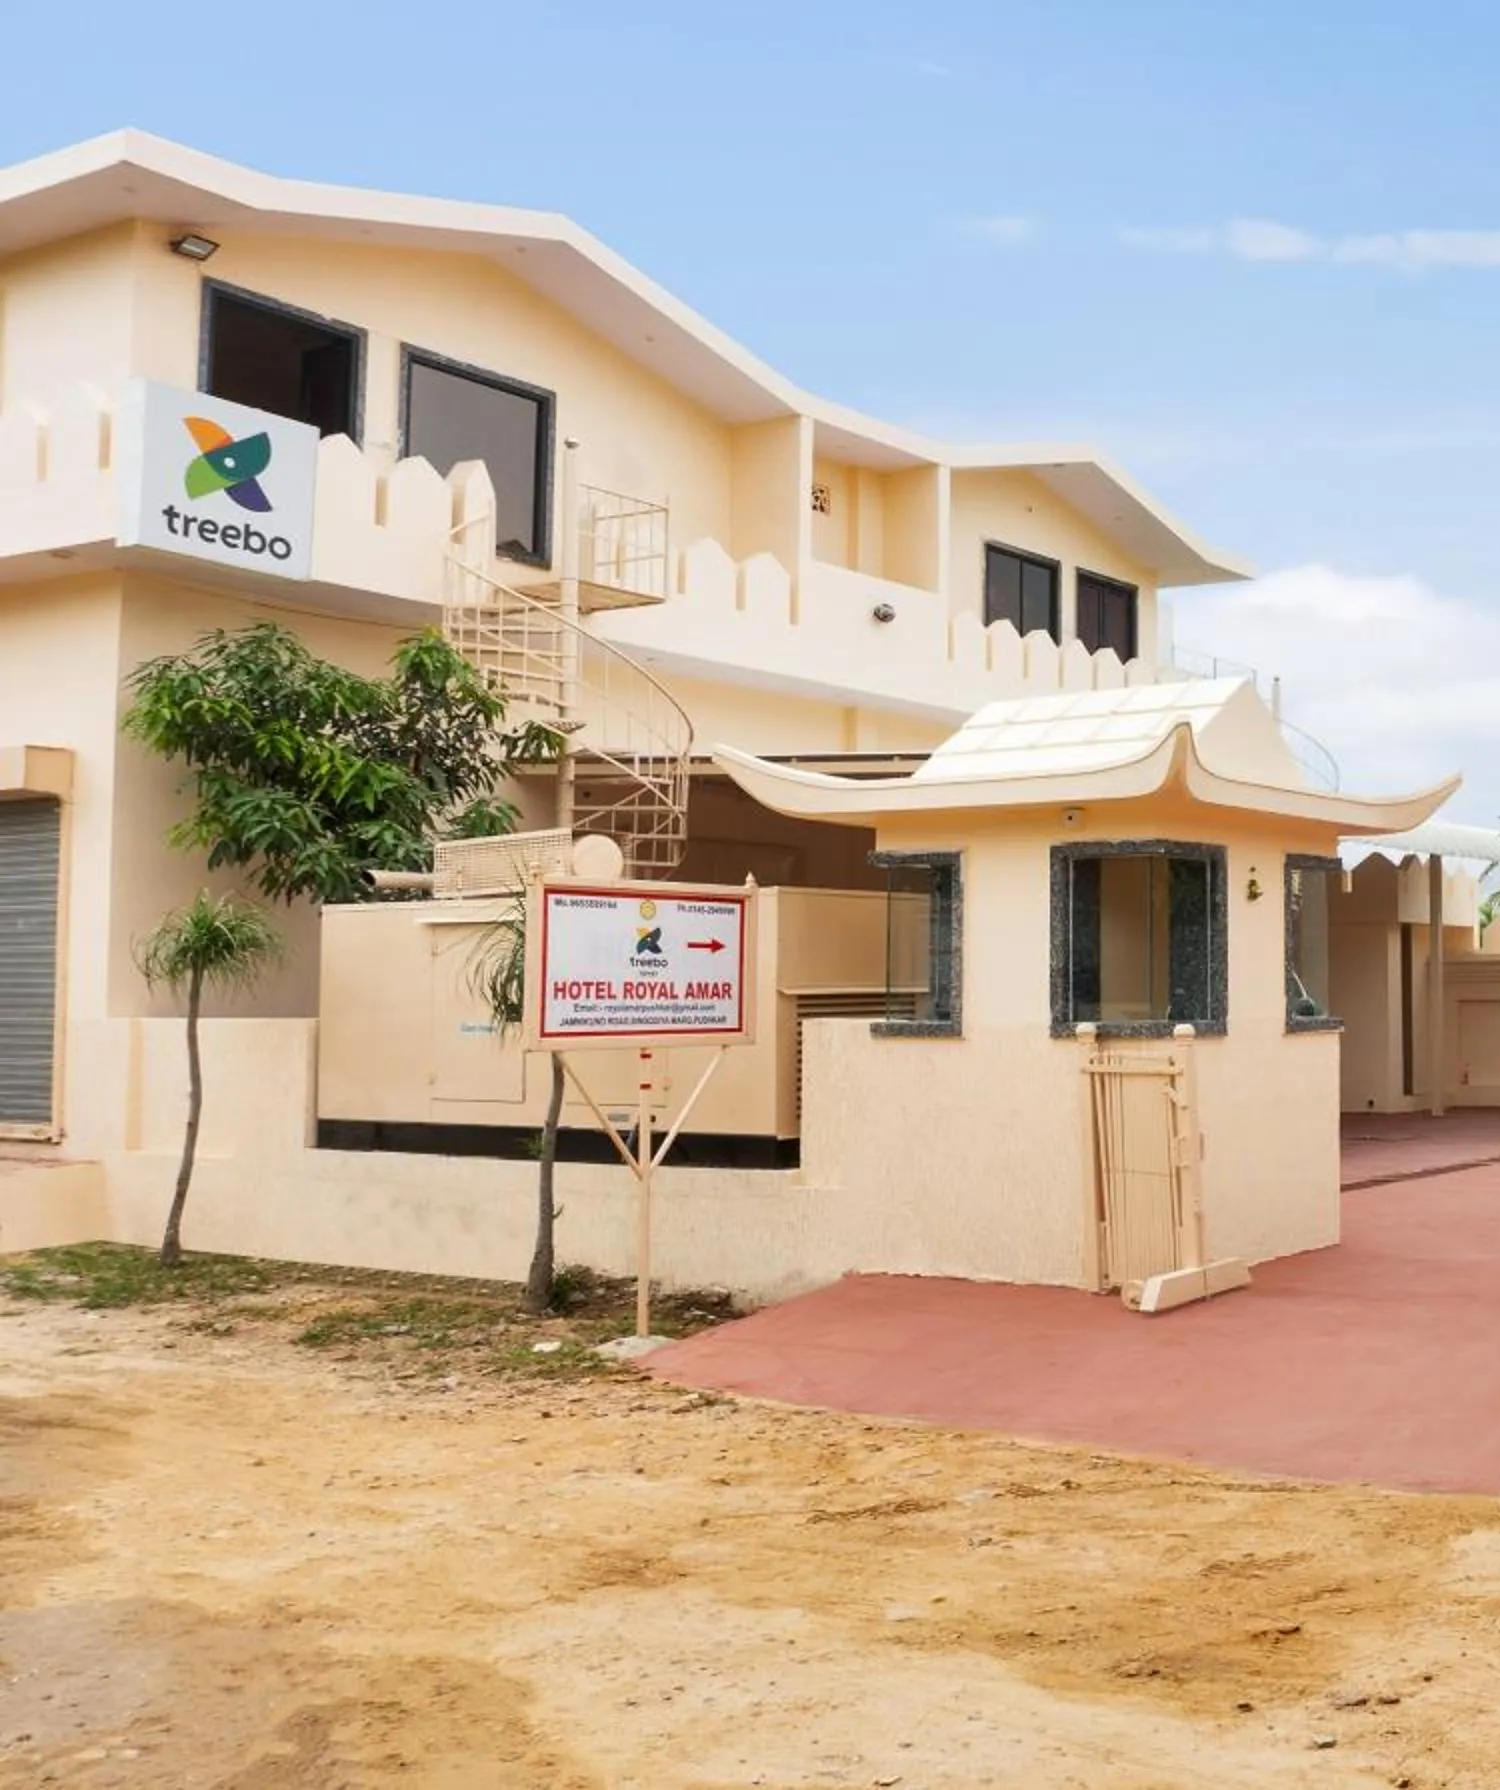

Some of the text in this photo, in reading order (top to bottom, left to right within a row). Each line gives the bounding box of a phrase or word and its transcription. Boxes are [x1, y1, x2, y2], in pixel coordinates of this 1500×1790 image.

[162, 504, 292, 560] treebo
[629, 956, 669, 968] treebo
[553, 981, 732, 1000] HOTEL ROYAL AMAR
